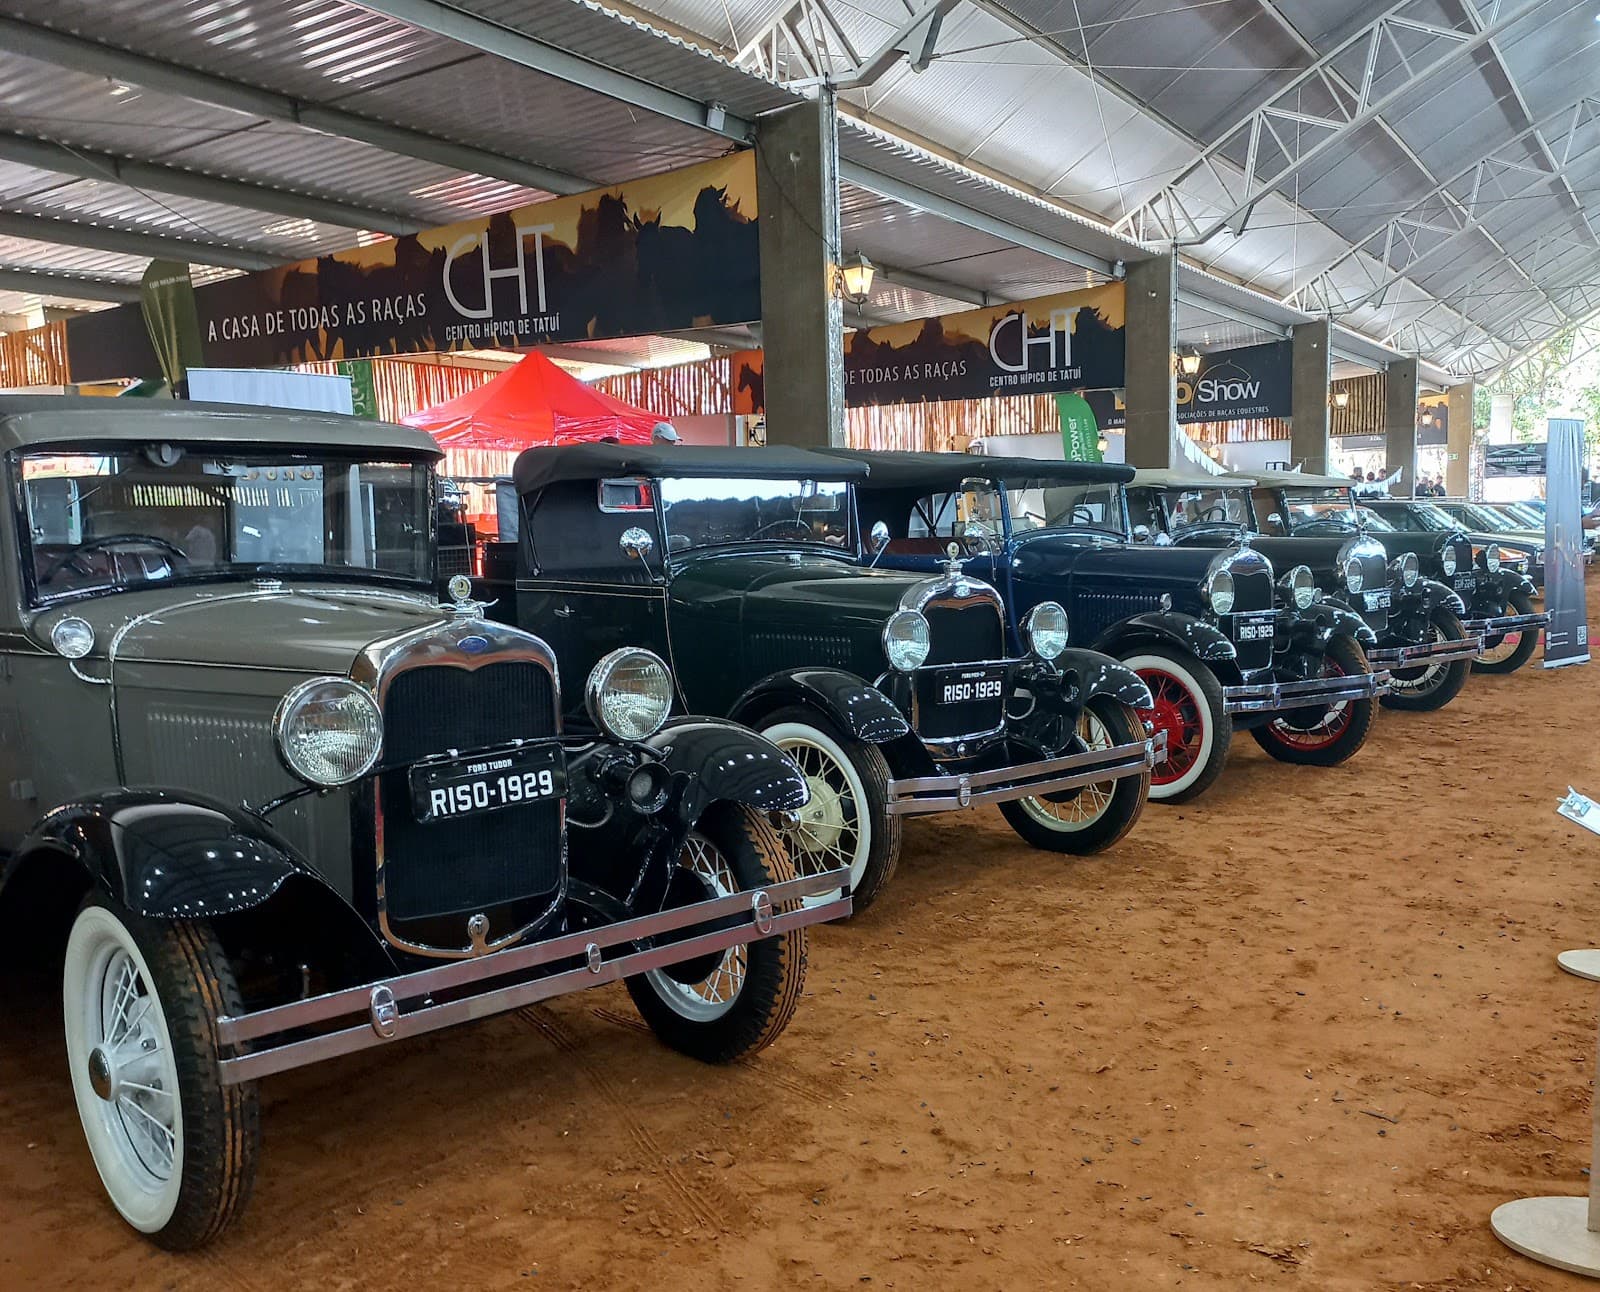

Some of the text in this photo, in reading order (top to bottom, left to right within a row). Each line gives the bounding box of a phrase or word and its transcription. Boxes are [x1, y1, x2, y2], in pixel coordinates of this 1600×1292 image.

[442, 223, 555, 319] CHT
[208, 293, 427, 342] A CASA DE TODAS AS RAÇAS
[445, 311, 560, 341] CENTRO HÍPICO DE TATUÍ
[989, 306, 1081, 372] CHT
[859, 366, 900, 384] TODAS
[903, 364, 920, 380] AS
[924, 359, 967, 381] RAÇAS
[989, 366, 1081, 388] CENTRO HÍPICO DE TATUÍ
[1197, 379, 1261, 403] Show
[1217, 408, 1236, 417] RAÇAS
[1236, 405, 1270, 415] EQUESTRES
[943, 680, 1002, 702] RISO-1929
[467, 758, 513, 774] FORD TUDOR
[430, 769, 554, 817] RISO-1929
